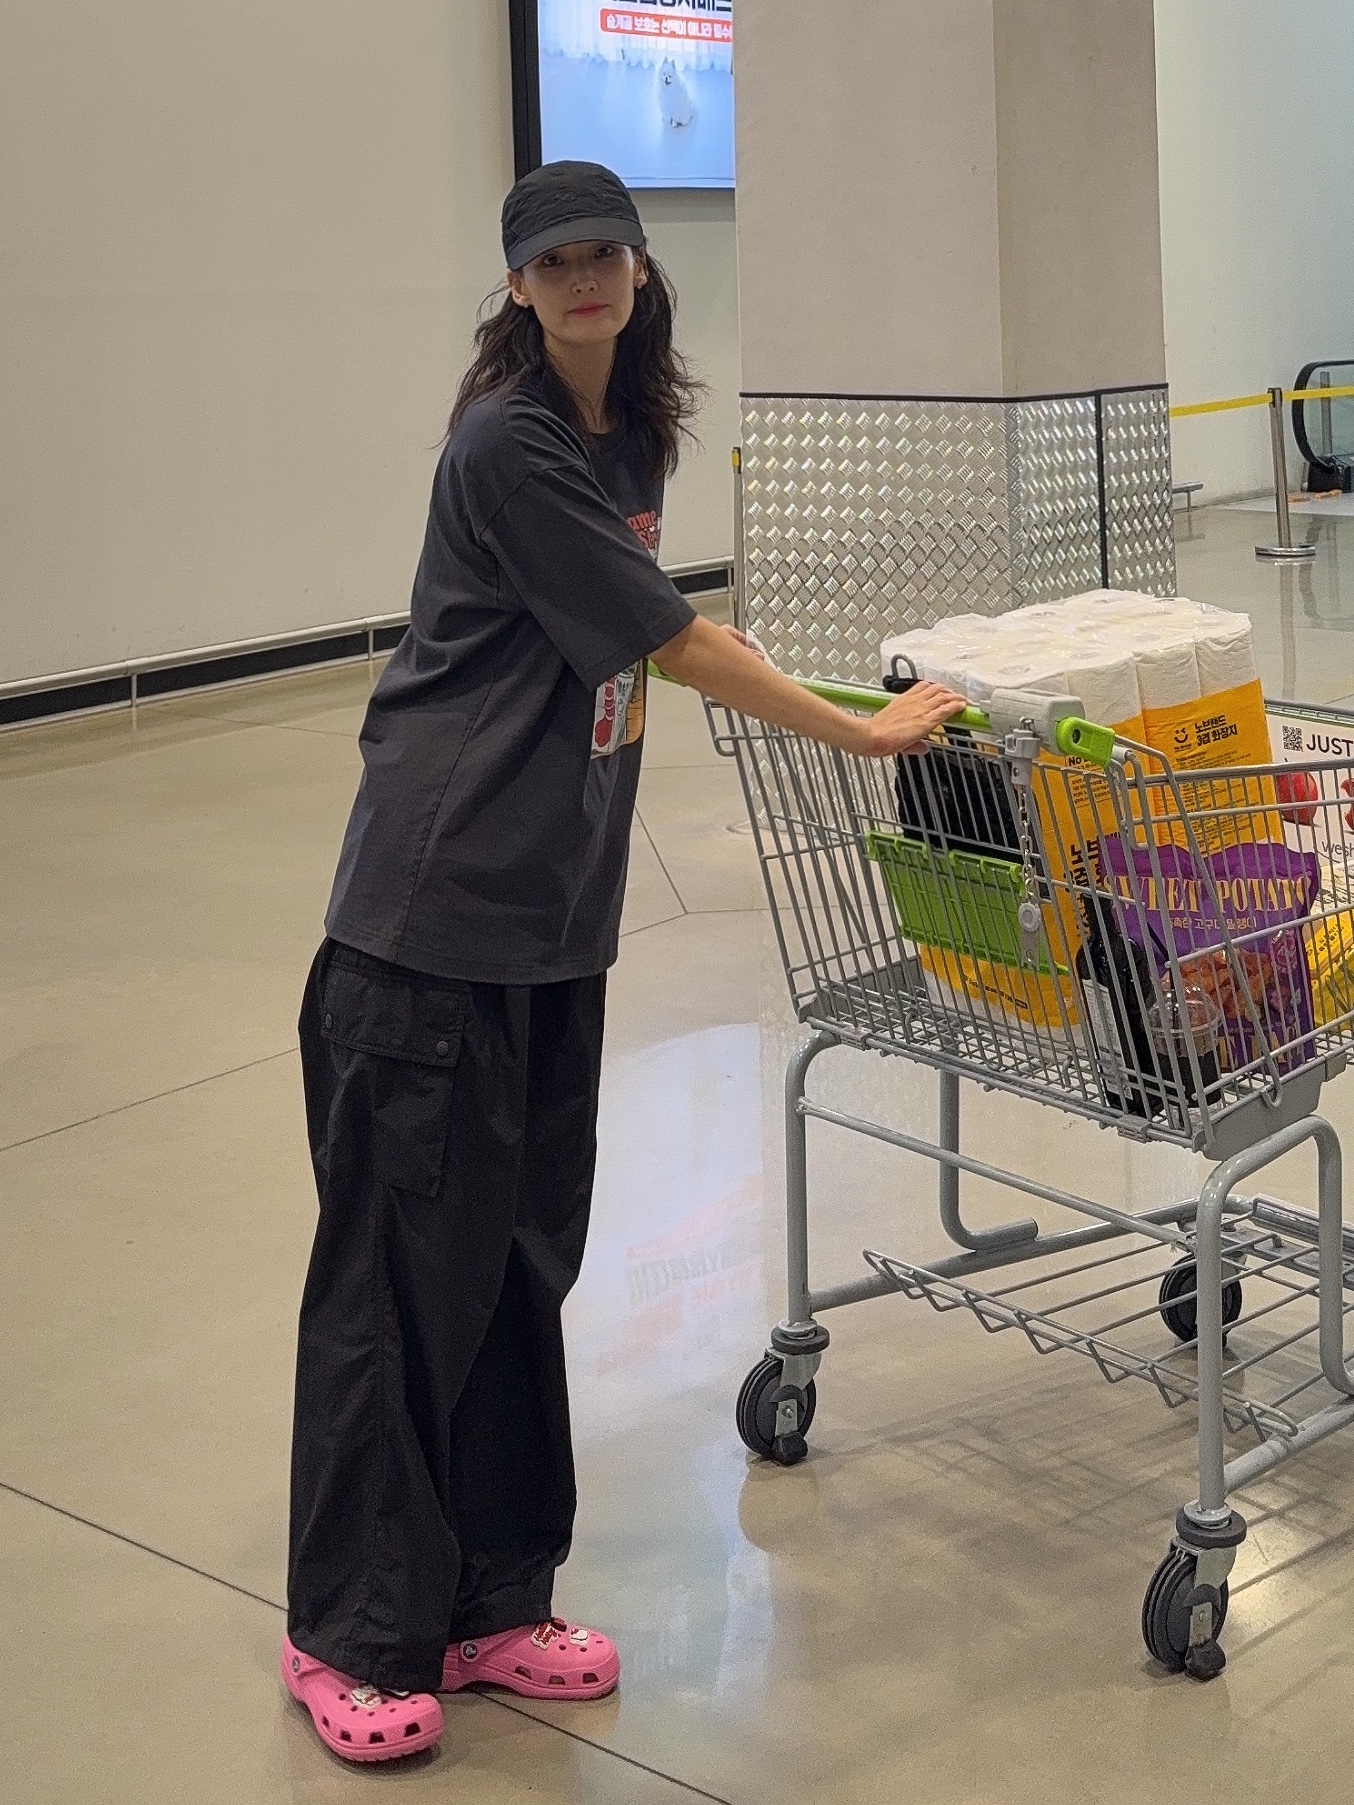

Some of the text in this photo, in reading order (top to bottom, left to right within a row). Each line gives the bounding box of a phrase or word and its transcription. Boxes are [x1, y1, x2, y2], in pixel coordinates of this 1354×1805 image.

[1194, 714, 1227, 734] 노브랜드
[1211, 723, 1238, 742] 화장지
[1306, 733, 1354, 757] JUST
[1216, 872, 1311, 913] POTATO
